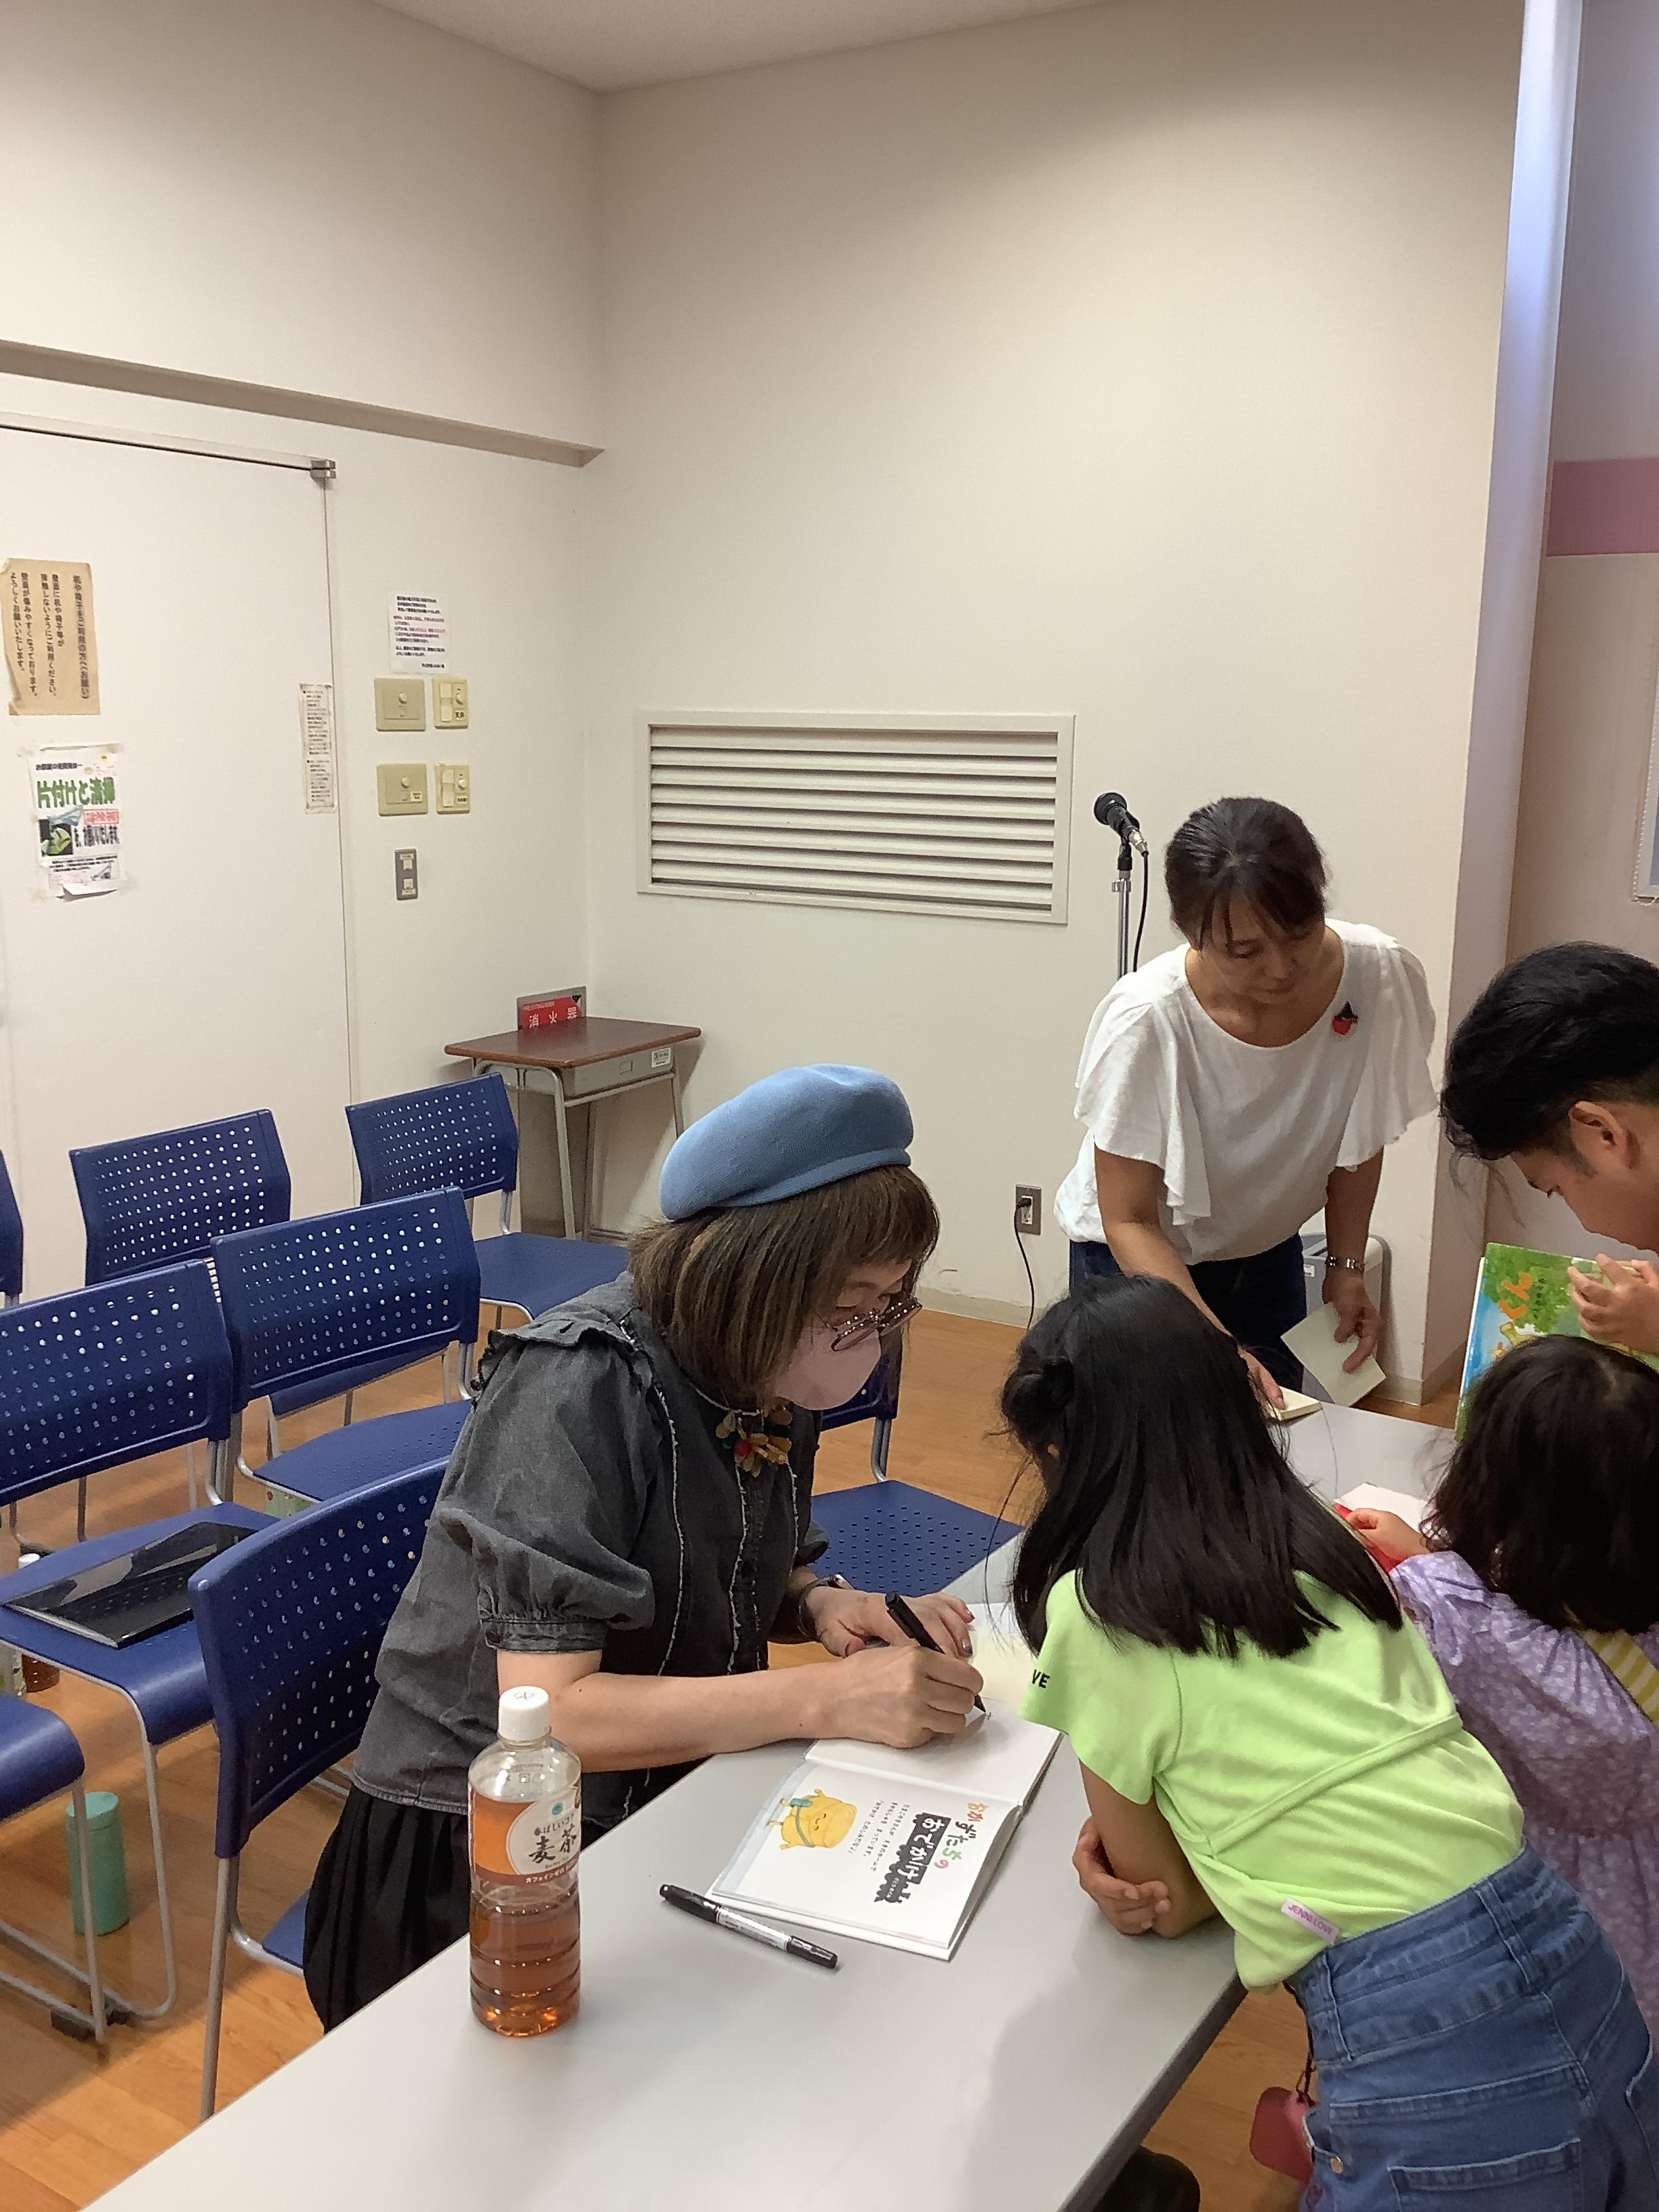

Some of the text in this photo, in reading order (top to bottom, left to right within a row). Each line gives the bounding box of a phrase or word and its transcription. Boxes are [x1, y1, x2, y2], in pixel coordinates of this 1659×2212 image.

[529, 1006, 577, 1028] 消火器
[1031, 1668, 1050, 1689] VE
[528, 1822, 577, 1864] 麦茶
[897, 1818, 944, 1879] おでかけ
[934, 1803, 987, 1868] おかずたちの
[869, 1839, 890, 1871] えきのホームで
[1288, 1904, 1334, 1936] JENNI LOVE
